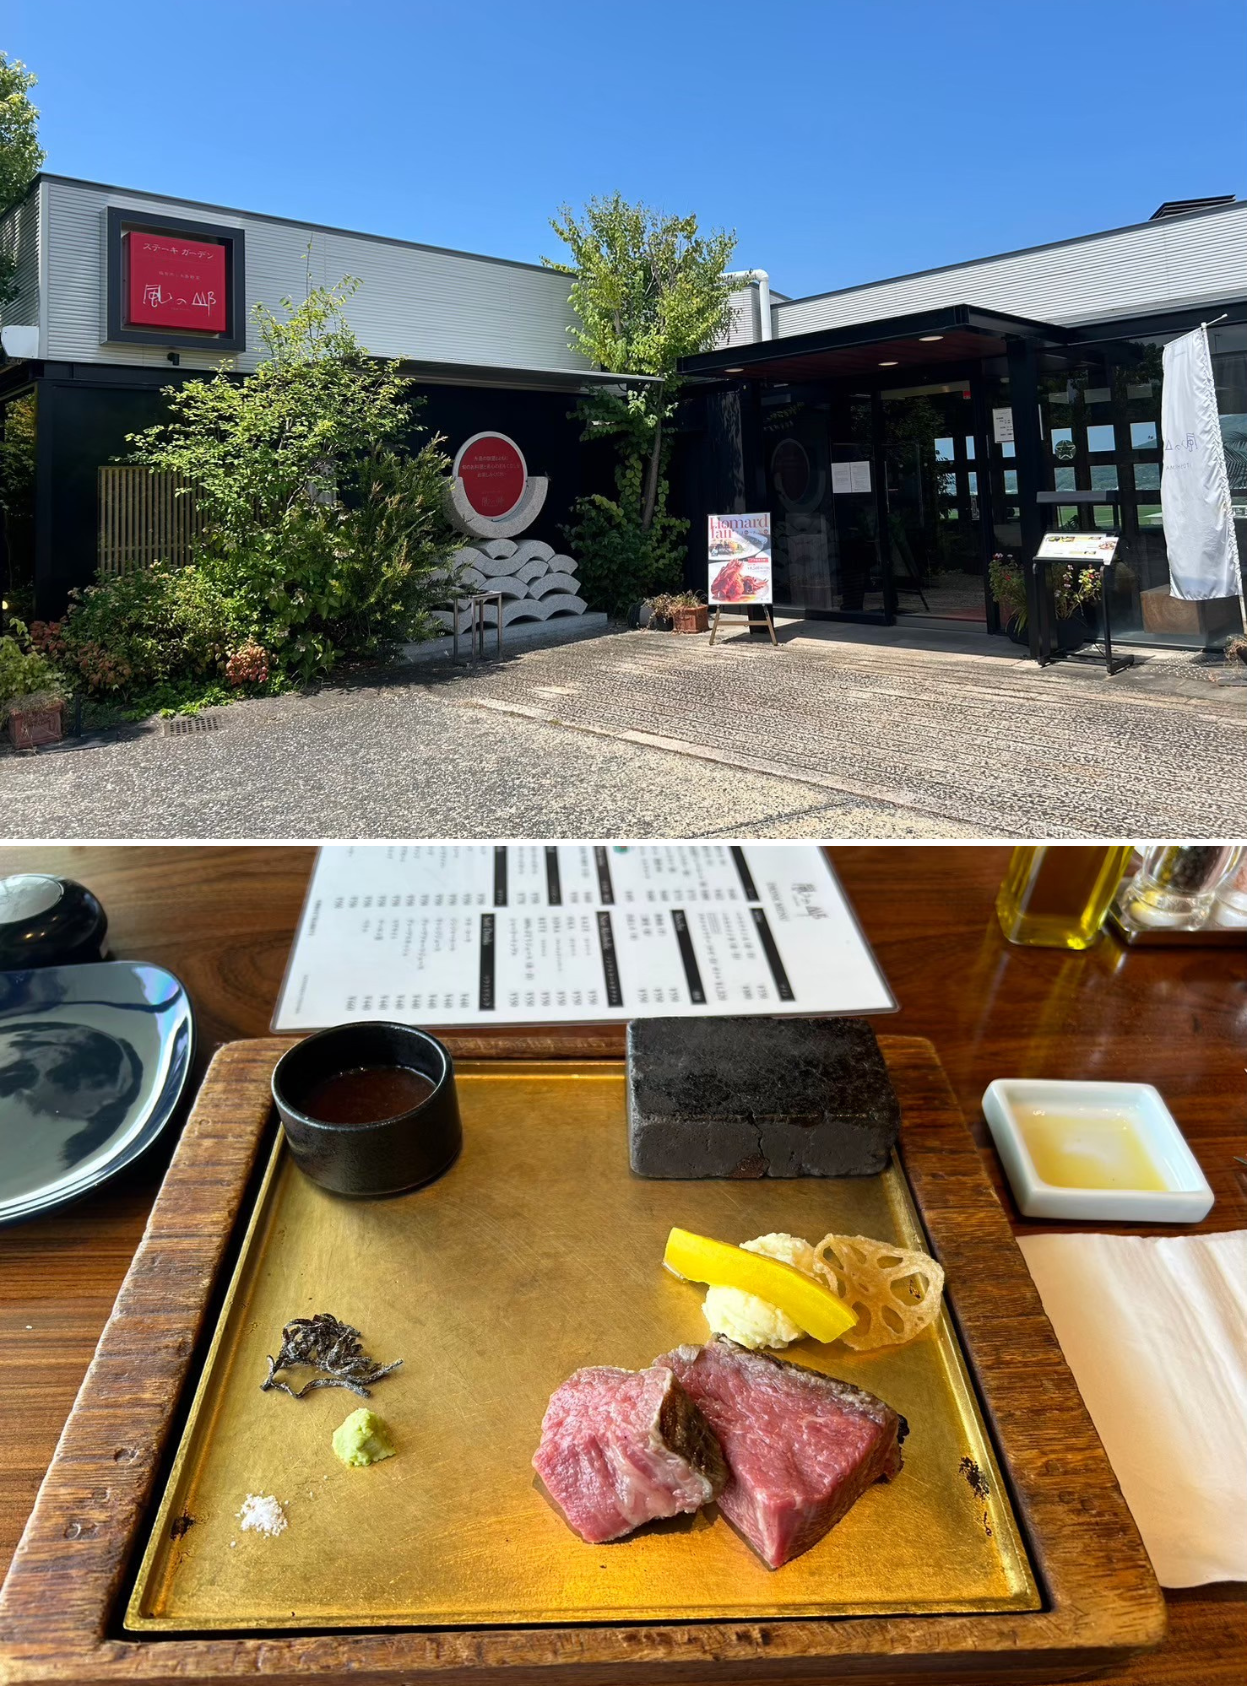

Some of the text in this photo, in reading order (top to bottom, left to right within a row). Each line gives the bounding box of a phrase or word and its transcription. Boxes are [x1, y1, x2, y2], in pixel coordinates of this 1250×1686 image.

[143, 243, 214, 259] ステーキ ガーデン
[710, 513, 769, 530] Homard
